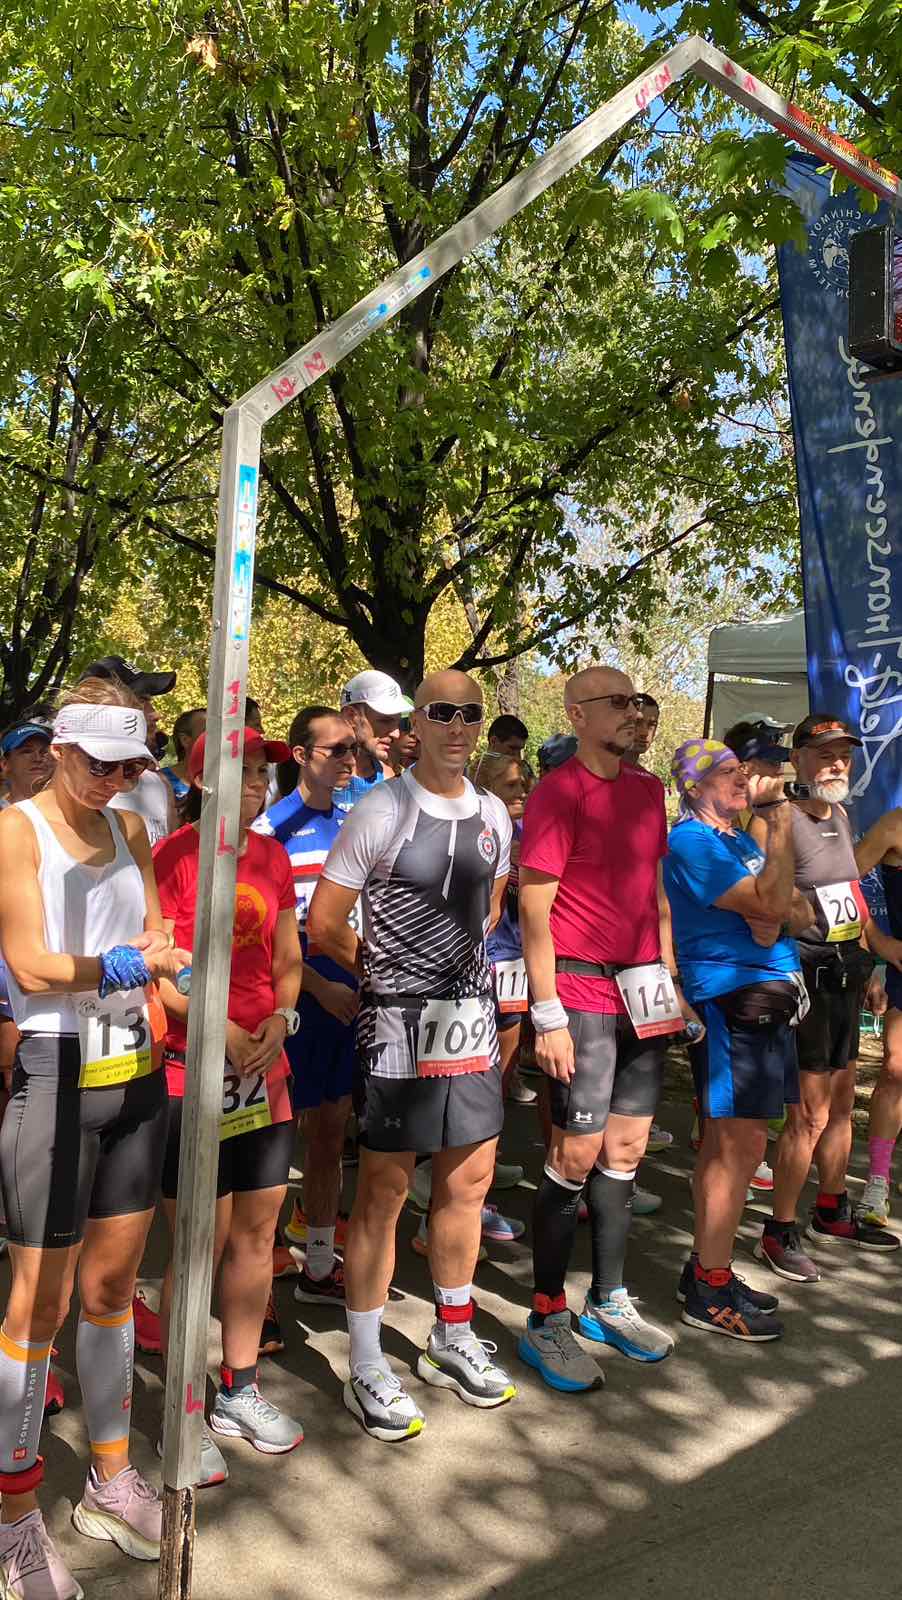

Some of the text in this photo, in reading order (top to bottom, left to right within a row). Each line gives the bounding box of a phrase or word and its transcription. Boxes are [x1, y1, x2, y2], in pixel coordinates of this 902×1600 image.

[829, 895, 858, 925] 20
[622, 982, 674, 1019] 114
[96, 1005, 147, 1057] 13
[423, 1016, 487, 1055] 109
